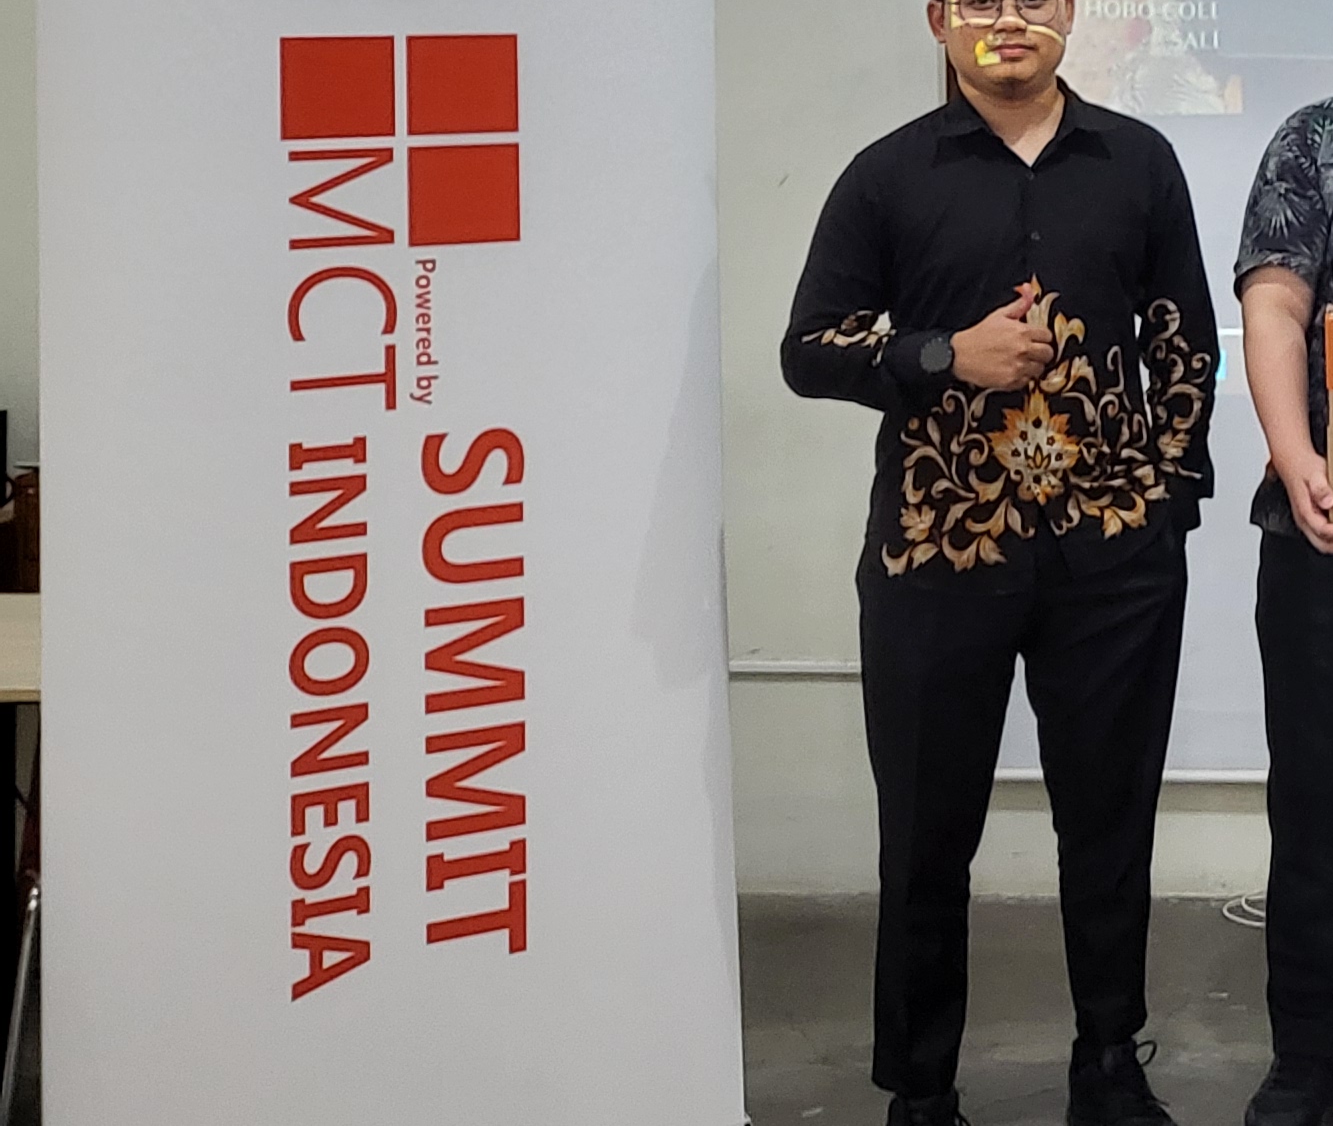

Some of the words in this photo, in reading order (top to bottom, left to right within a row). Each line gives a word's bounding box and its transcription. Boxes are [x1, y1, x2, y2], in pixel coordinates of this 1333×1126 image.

[288, 147, 398, 411] MCT
[409, 374, 440, 405] by
[415, 258, 439, 367] Powered
[288, 434, 372, 1003] INDONESIA
[420, 427, 528, 955] SUMMIT
